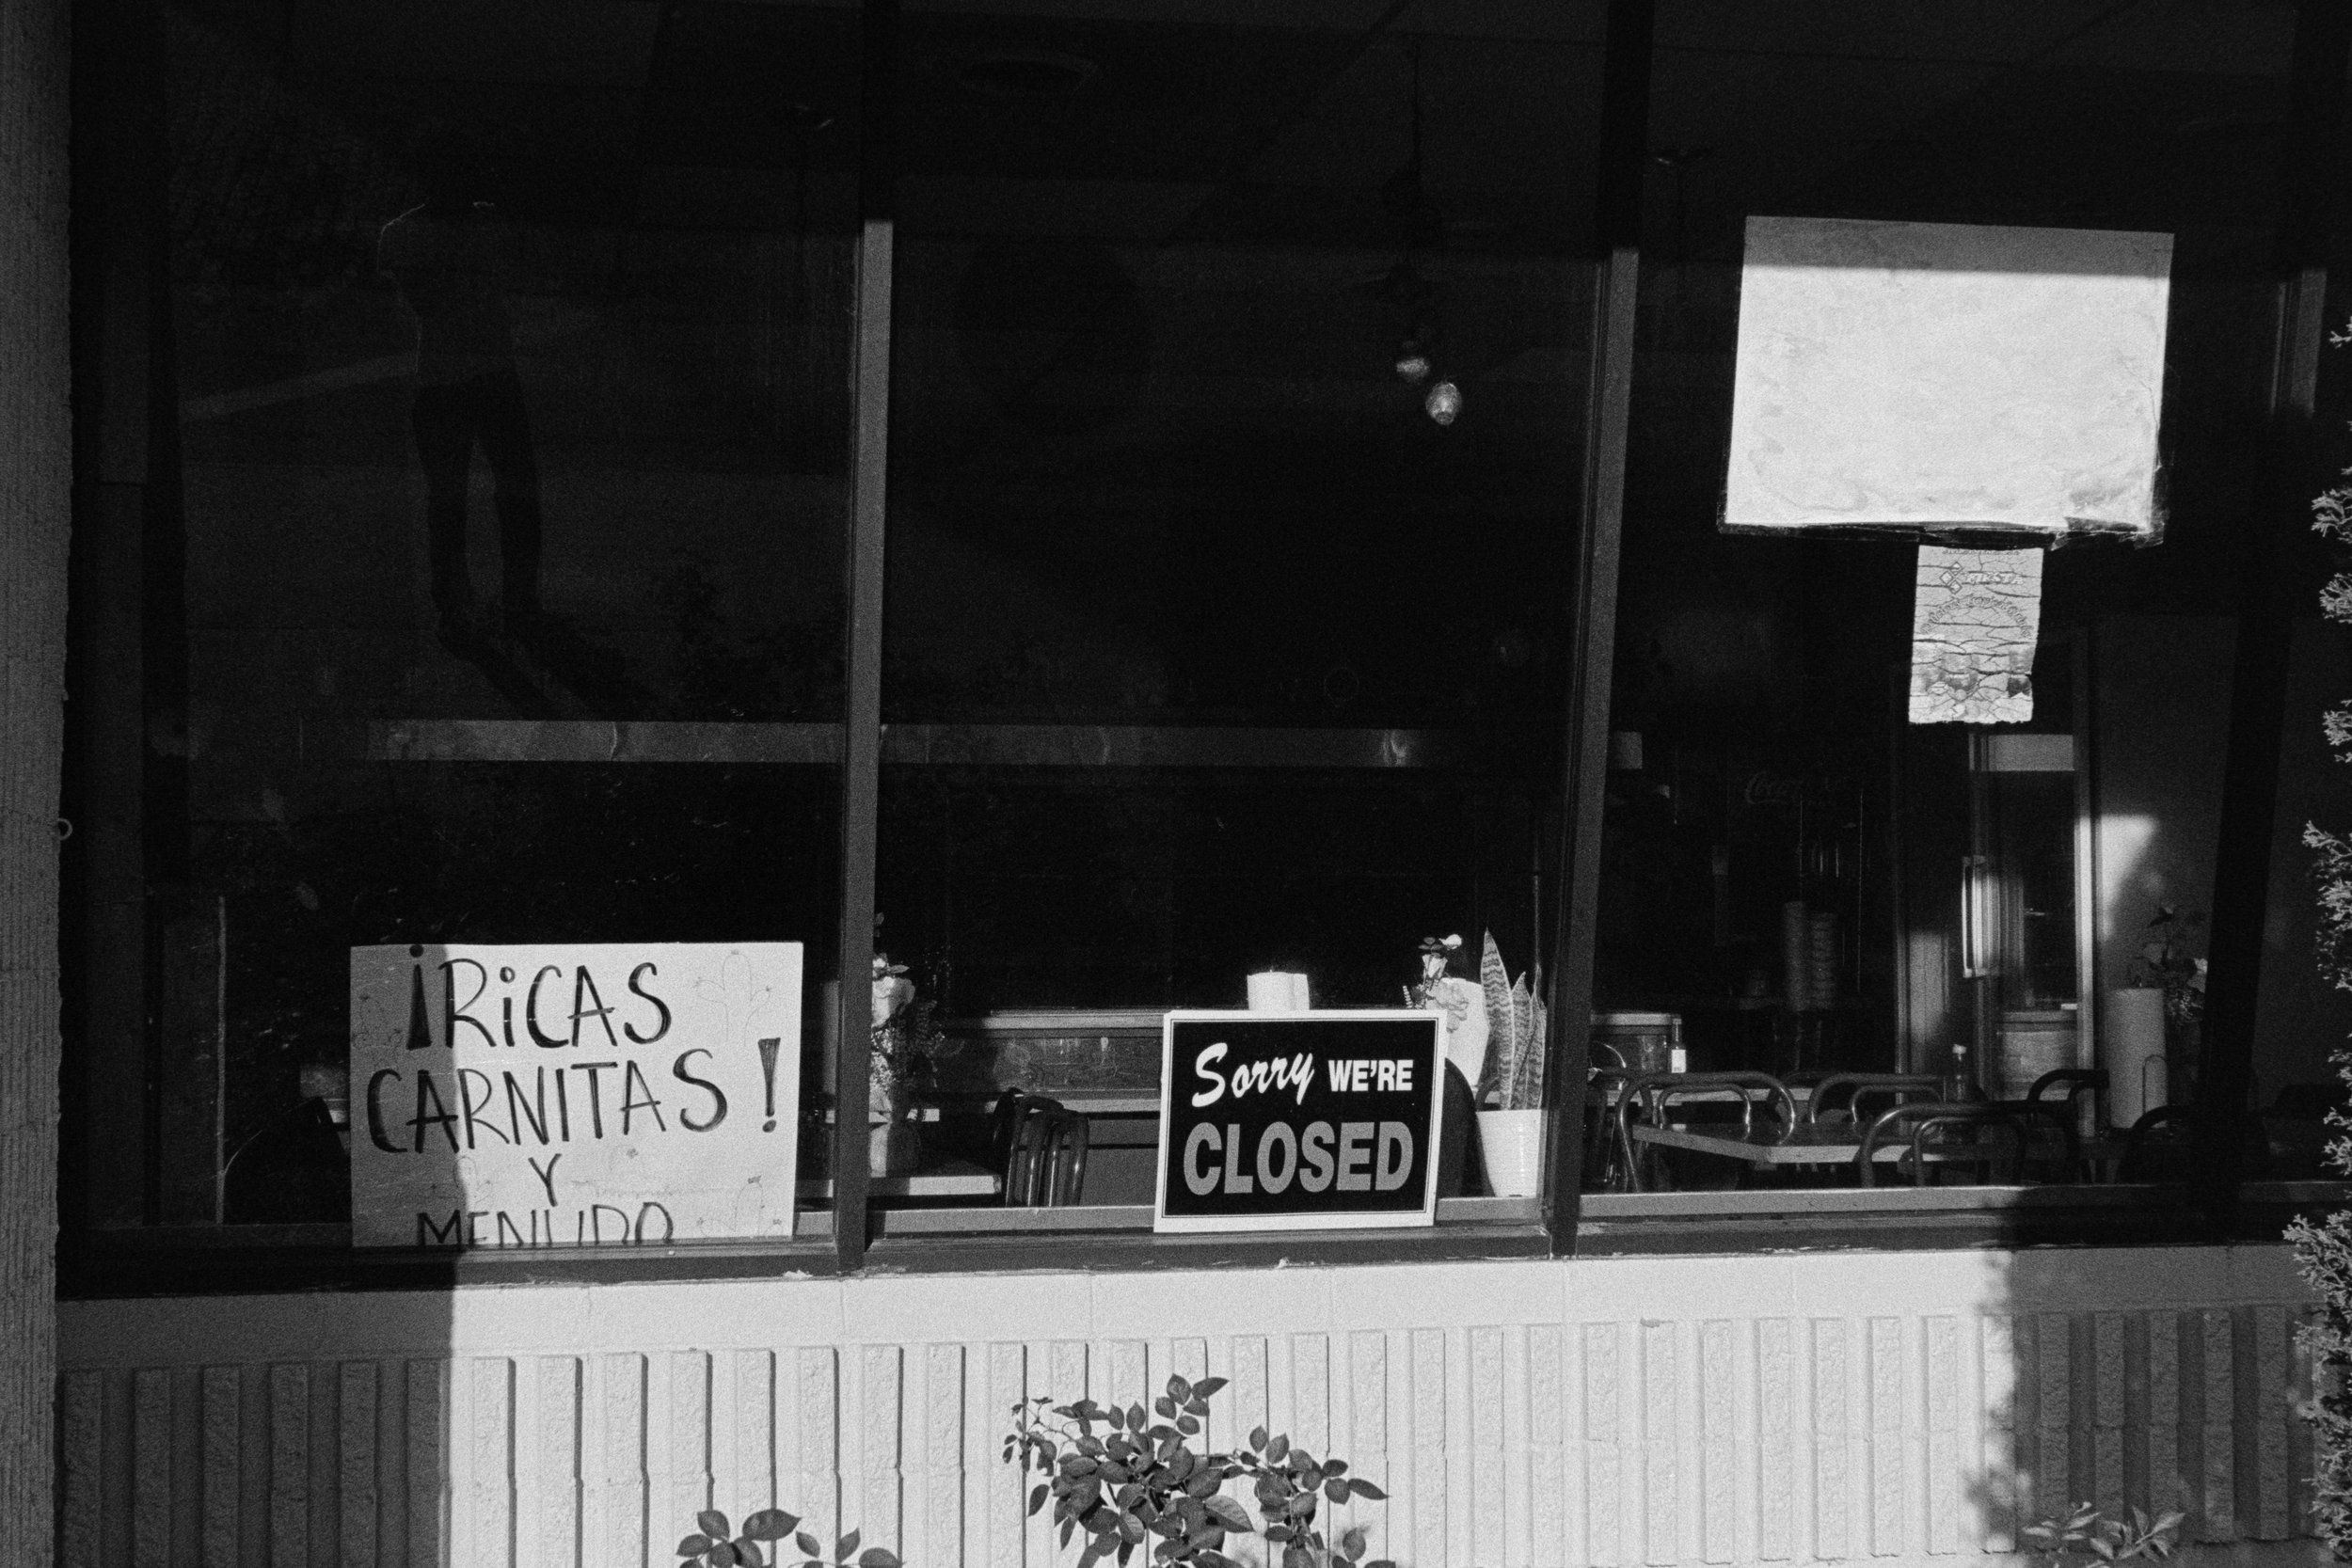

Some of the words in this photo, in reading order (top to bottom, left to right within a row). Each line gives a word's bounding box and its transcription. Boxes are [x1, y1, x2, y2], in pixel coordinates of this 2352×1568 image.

[1191, 1042, 1314, 1107] Sorry
[1327, 1059, 1414, 1092] WE'RE
[527, 1152, 563, 1208] Y
[1183, 1121, 1413, 1196] CLOSED
[417, 1201, 675, 1247] MENUDO
